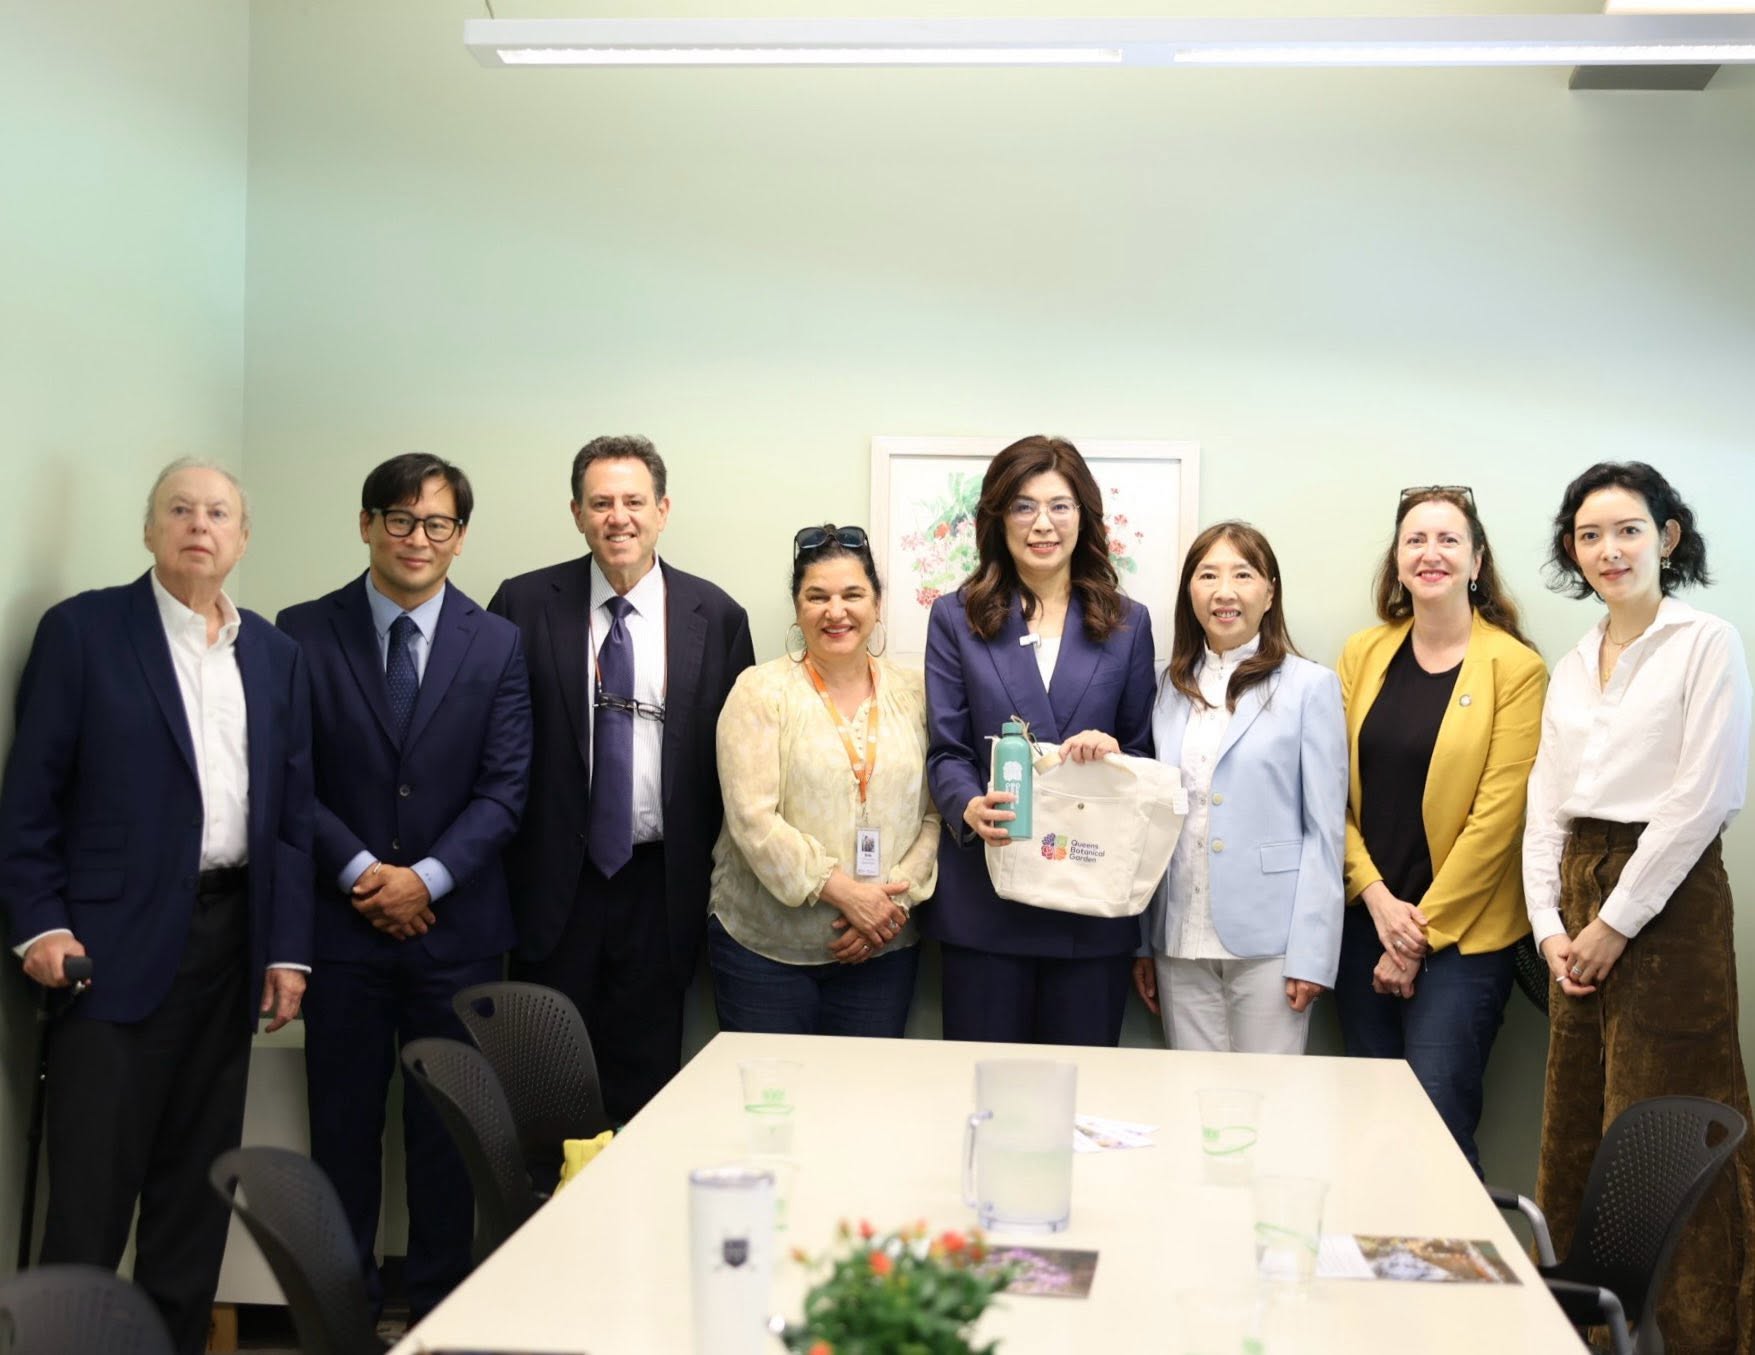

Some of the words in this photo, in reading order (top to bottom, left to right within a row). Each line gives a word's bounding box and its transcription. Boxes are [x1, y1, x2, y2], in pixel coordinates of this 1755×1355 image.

[1071, 839, 1099, 849] Queens
[1070, 846, 1105, 857] Botanical
[1069, 853, 1097, 863] Garden
